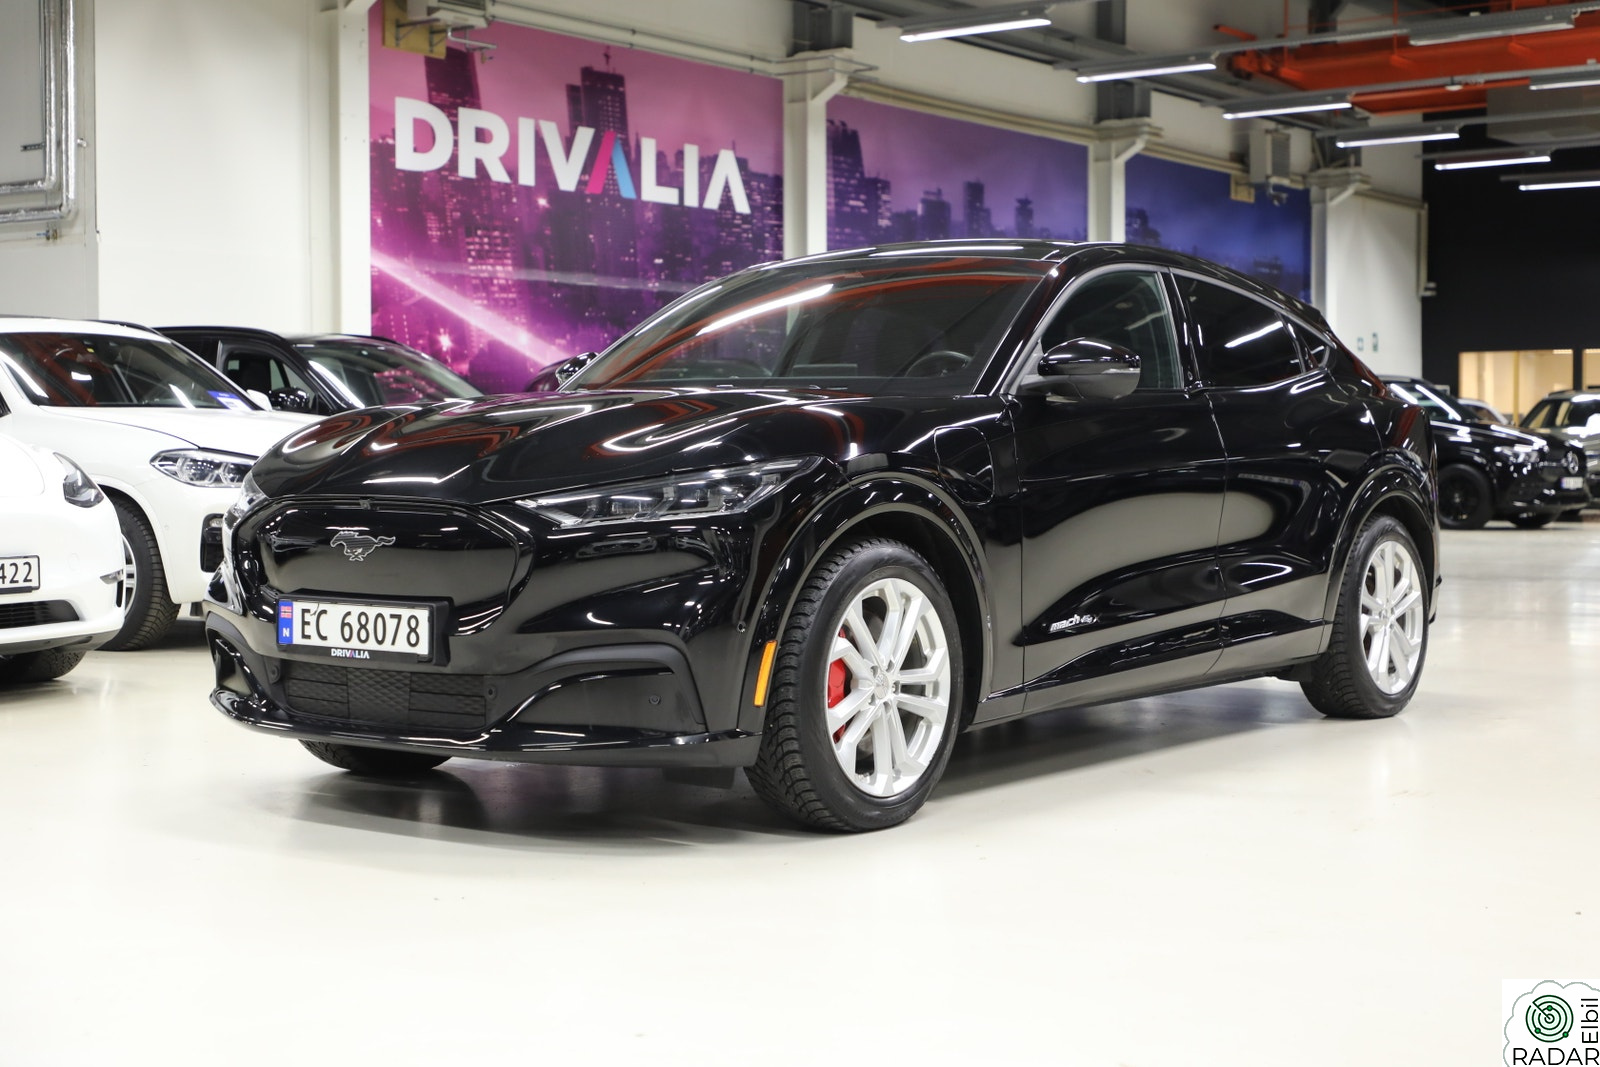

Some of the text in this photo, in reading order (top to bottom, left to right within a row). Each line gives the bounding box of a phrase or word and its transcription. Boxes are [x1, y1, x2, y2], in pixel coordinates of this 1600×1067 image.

[395, 97, 751, 214] DRIVALIA
[282, 627, 290, 638] N
[301, 608, 420, 648] EC 68078
[331, 648, 370, 659] DRIVALIA
